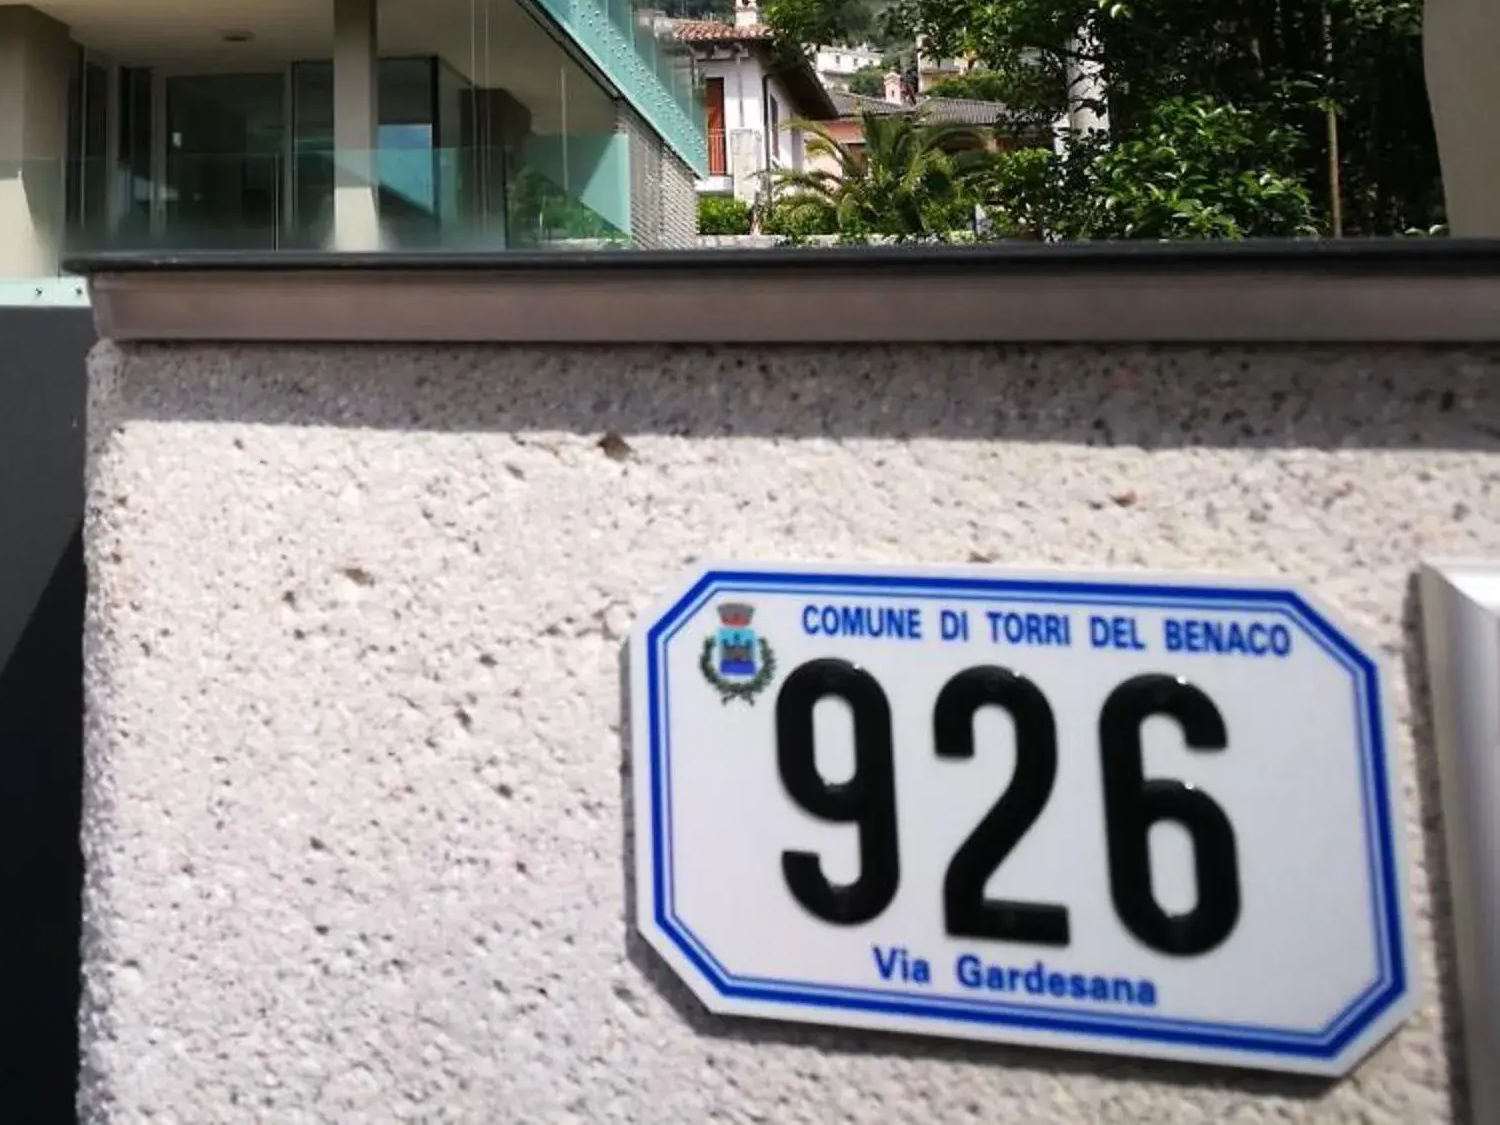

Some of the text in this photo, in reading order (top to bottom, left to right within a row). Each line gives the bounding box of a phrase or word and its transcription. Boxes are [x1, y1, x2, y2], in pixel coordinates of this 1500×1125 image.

[802, 604, 1293, 658] COMUNE DI TORRI DEL BENACO
[774, 657, 1243, 961] 926
[872, 946, 1159, 1009] Via Gardesana
